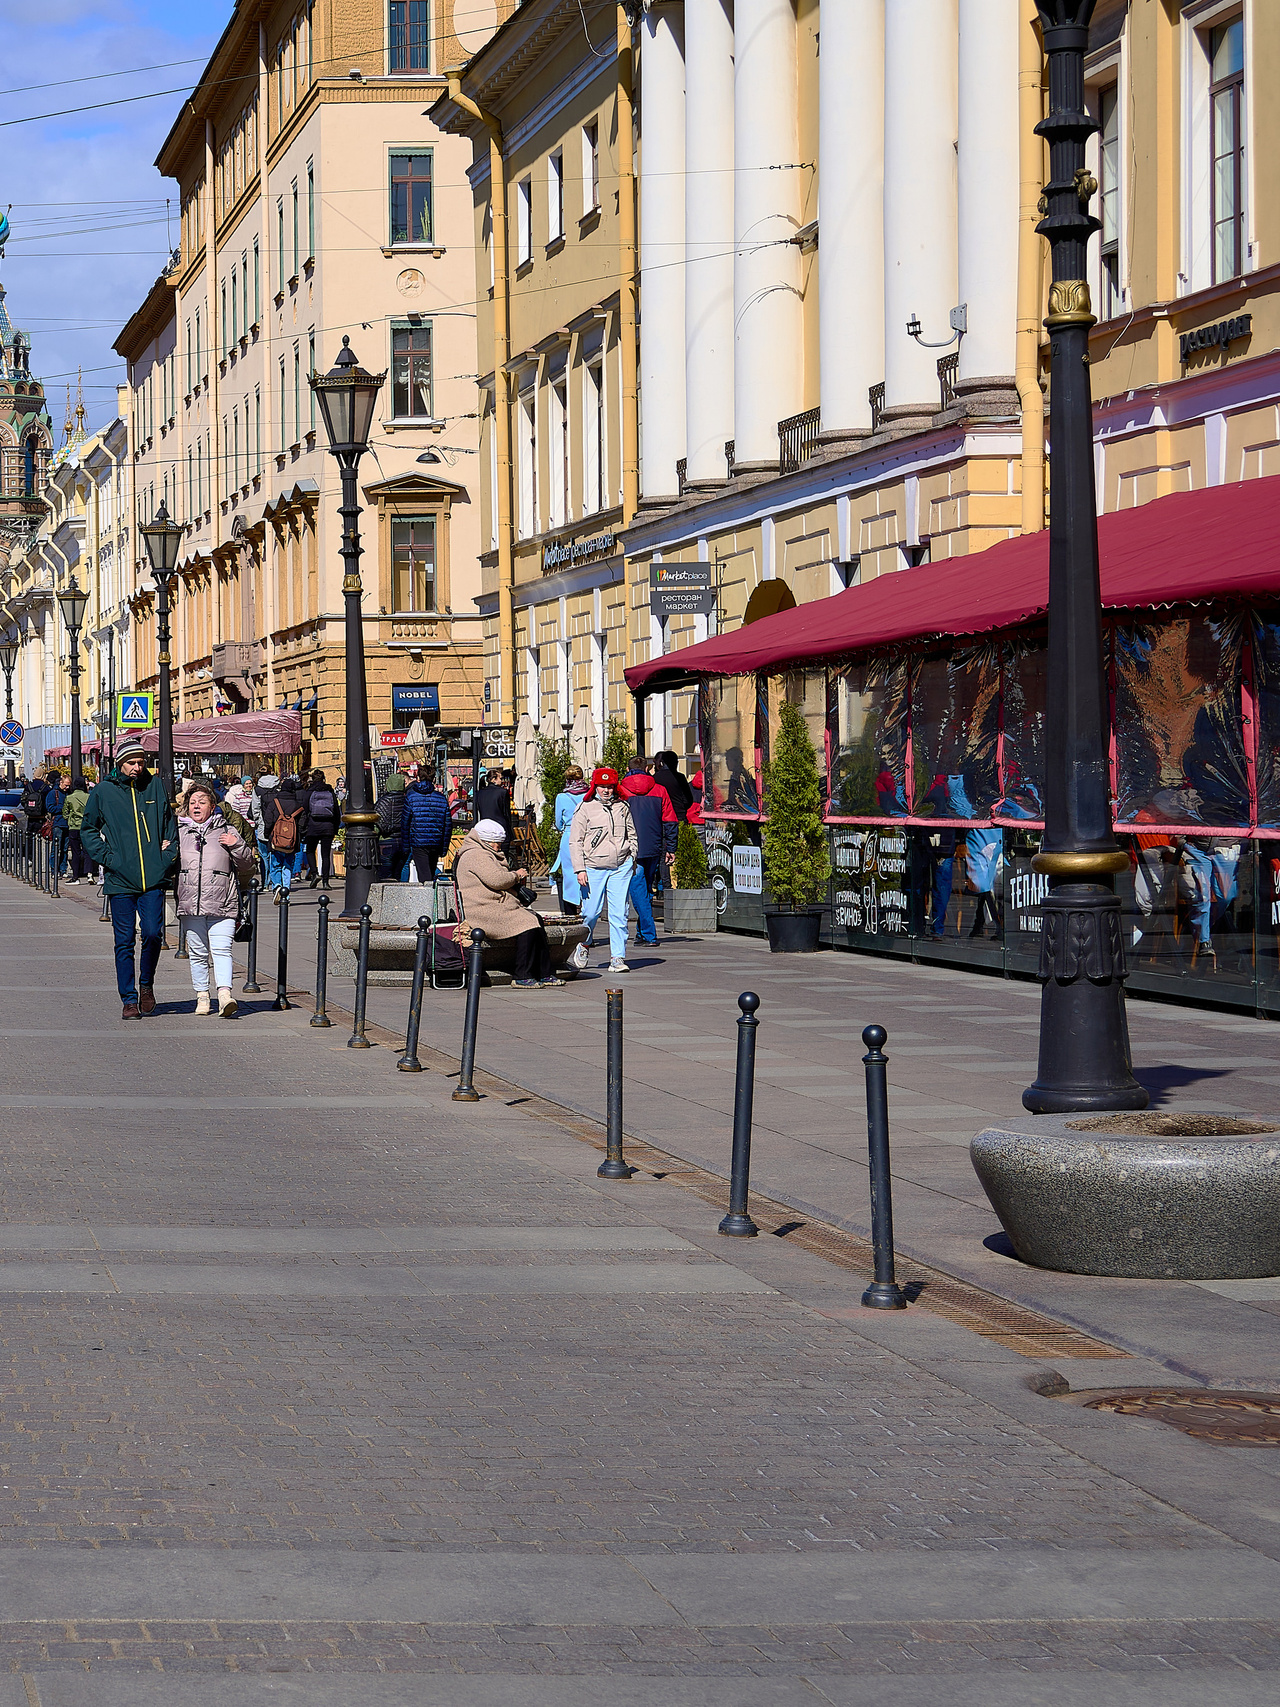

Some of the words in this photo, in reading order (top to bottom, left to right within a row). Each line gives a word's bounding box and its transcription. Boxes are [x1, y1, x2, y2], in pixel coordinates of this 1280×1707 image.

[1179, 314, 1252, 363] ресторан
[661, 570, 708, 581] Marketplace
[661, 595, 702, 603] ресторан
[665, 603, 698, 611] маркет
[485, 729, 510, 743] ICE
[707, 848, 732, 872] ЗАВТРАКИ
[879, 858, 906, 874] ХАЧАПУРИ
[836, 890, 861, 907] ГРУЗИНСКОЕ
[839, 906, 858, 927] ВИНО
